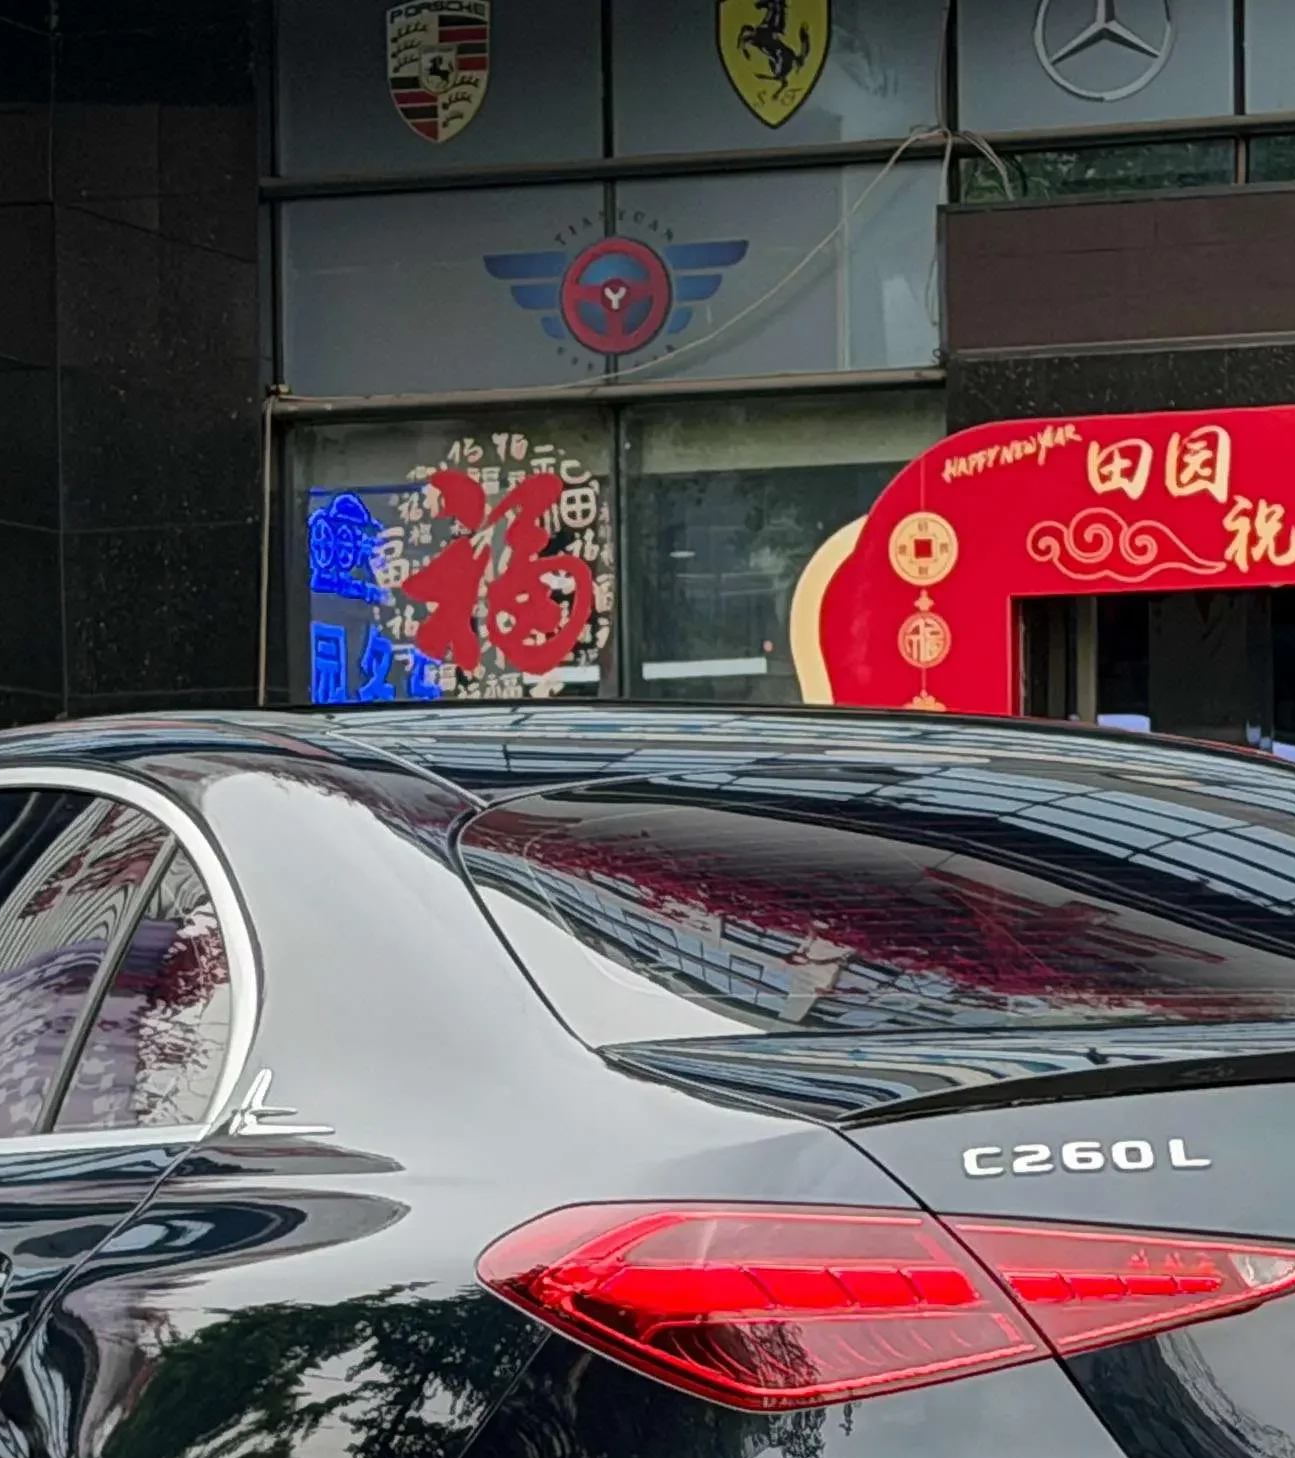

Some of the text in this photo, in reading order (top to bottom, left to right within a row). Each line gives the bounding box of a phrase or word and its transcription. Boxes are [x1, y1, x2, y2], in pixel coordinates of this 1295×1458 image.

[941, 423, 1083, 484] HAPPY NEW YEAR
[1086, 425, 1231, 502] 田园
[402, 468, 593, 676] 福
